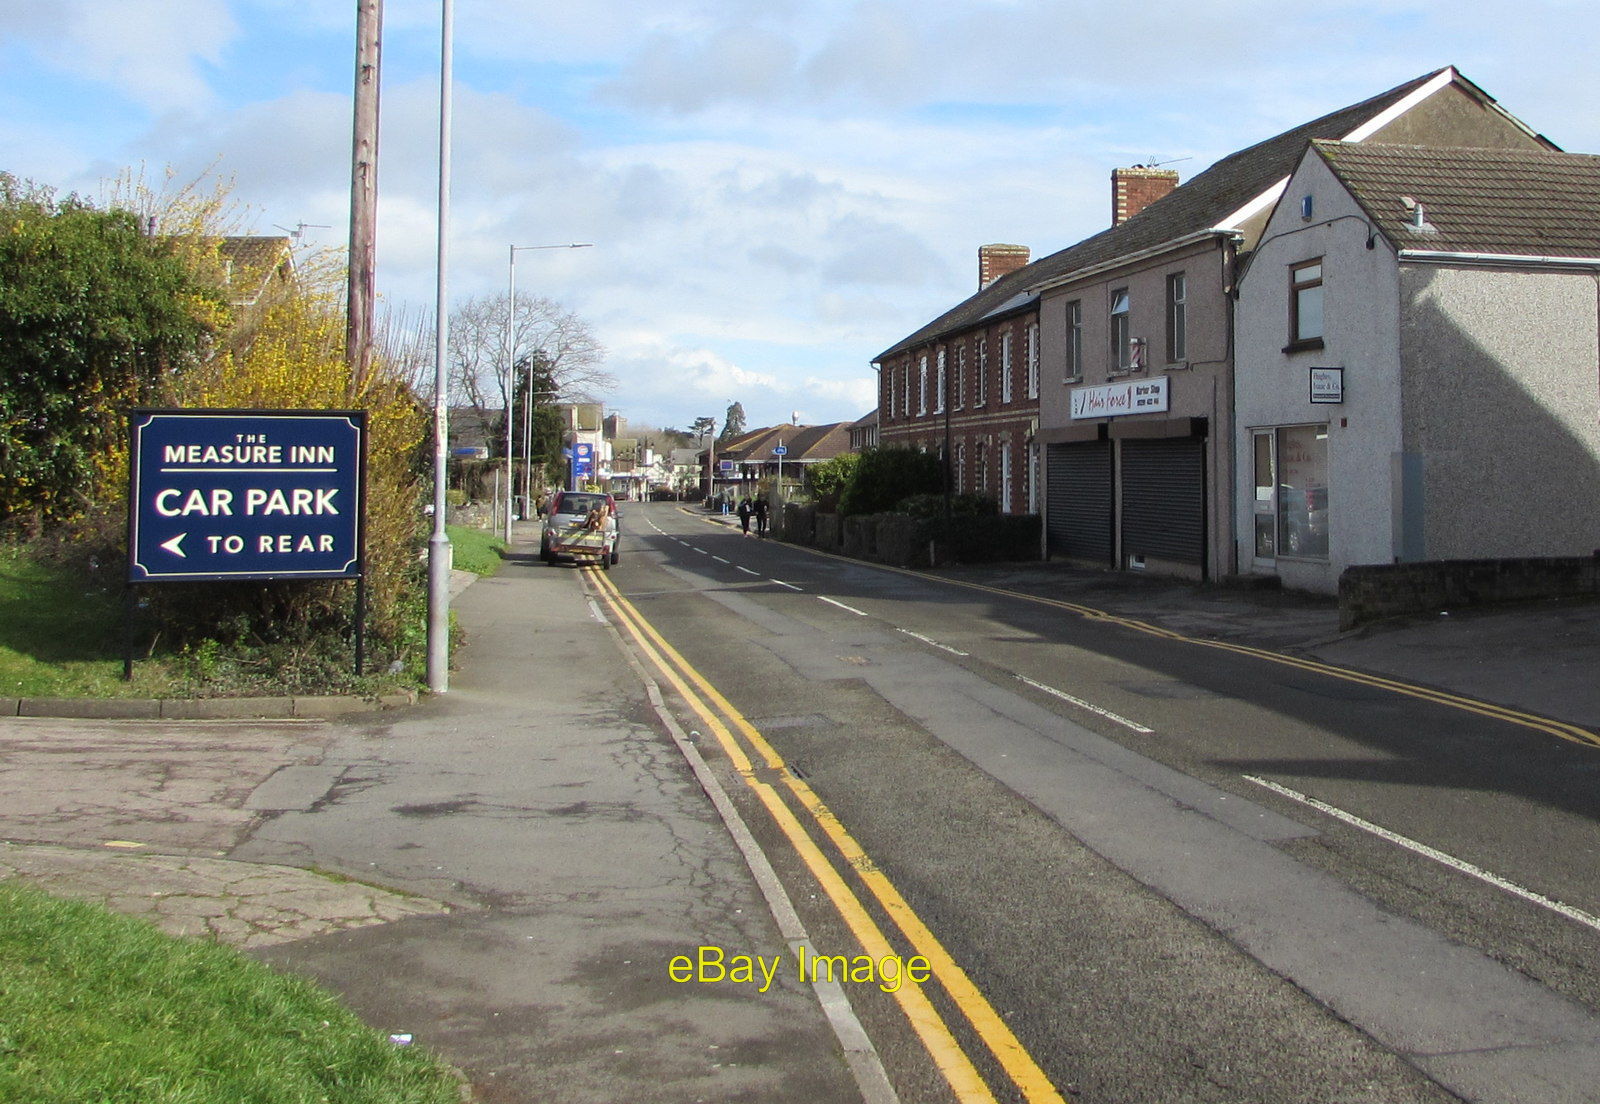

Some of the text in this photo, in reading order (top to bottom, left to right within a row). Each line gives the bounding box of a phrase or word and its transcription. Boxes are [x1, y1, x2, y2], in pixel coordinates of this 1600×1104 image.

[236, 434, 266, 444] THE
[164, 445, 335, 464] MEASURE INN
[155, 488, 340, 517] CAR PARK
[207, 535, 334, 554] TO REAR
